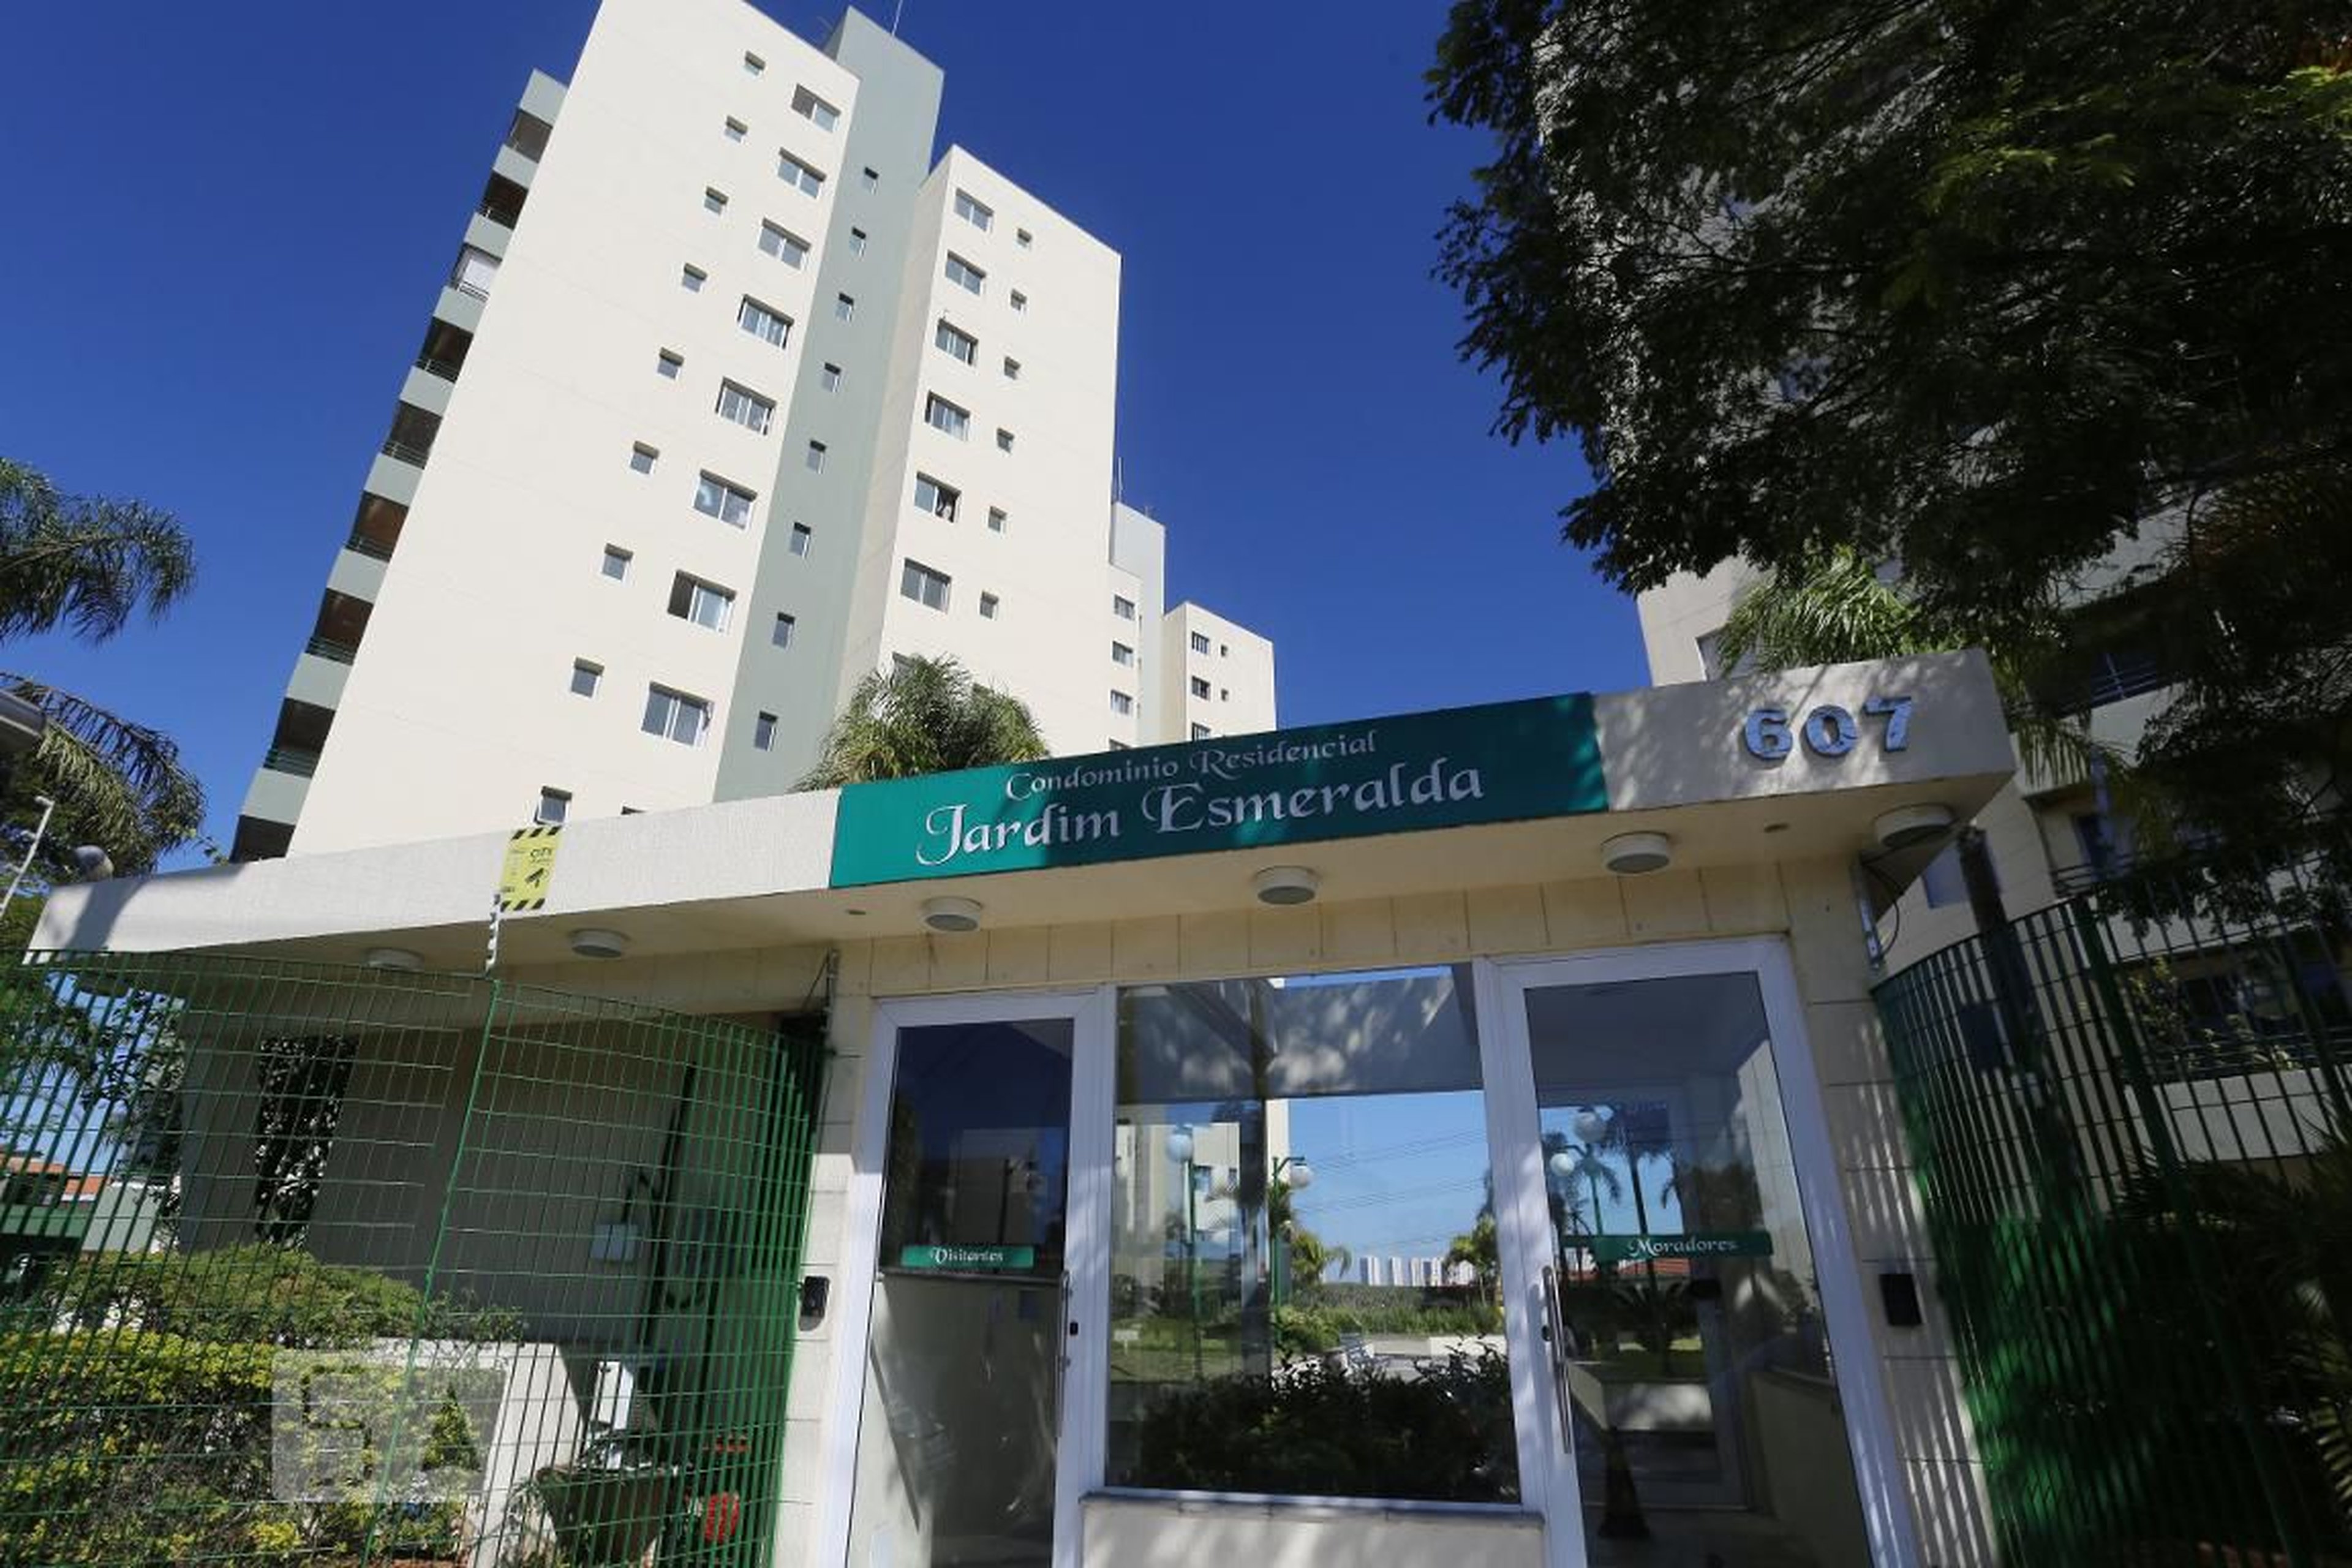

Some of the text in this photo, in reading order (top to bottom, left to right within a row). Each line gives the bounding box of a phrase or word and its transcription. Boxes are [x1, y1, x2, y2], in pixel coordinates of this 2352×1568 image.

[1744, 696, 1913, 760] 607
[1006, 729, 1378, 801] Condominio Residencial
[915, 757, 1485, 867] Jardim Esmeralda
[1627, 1235, 1740, 1257] Moradores
